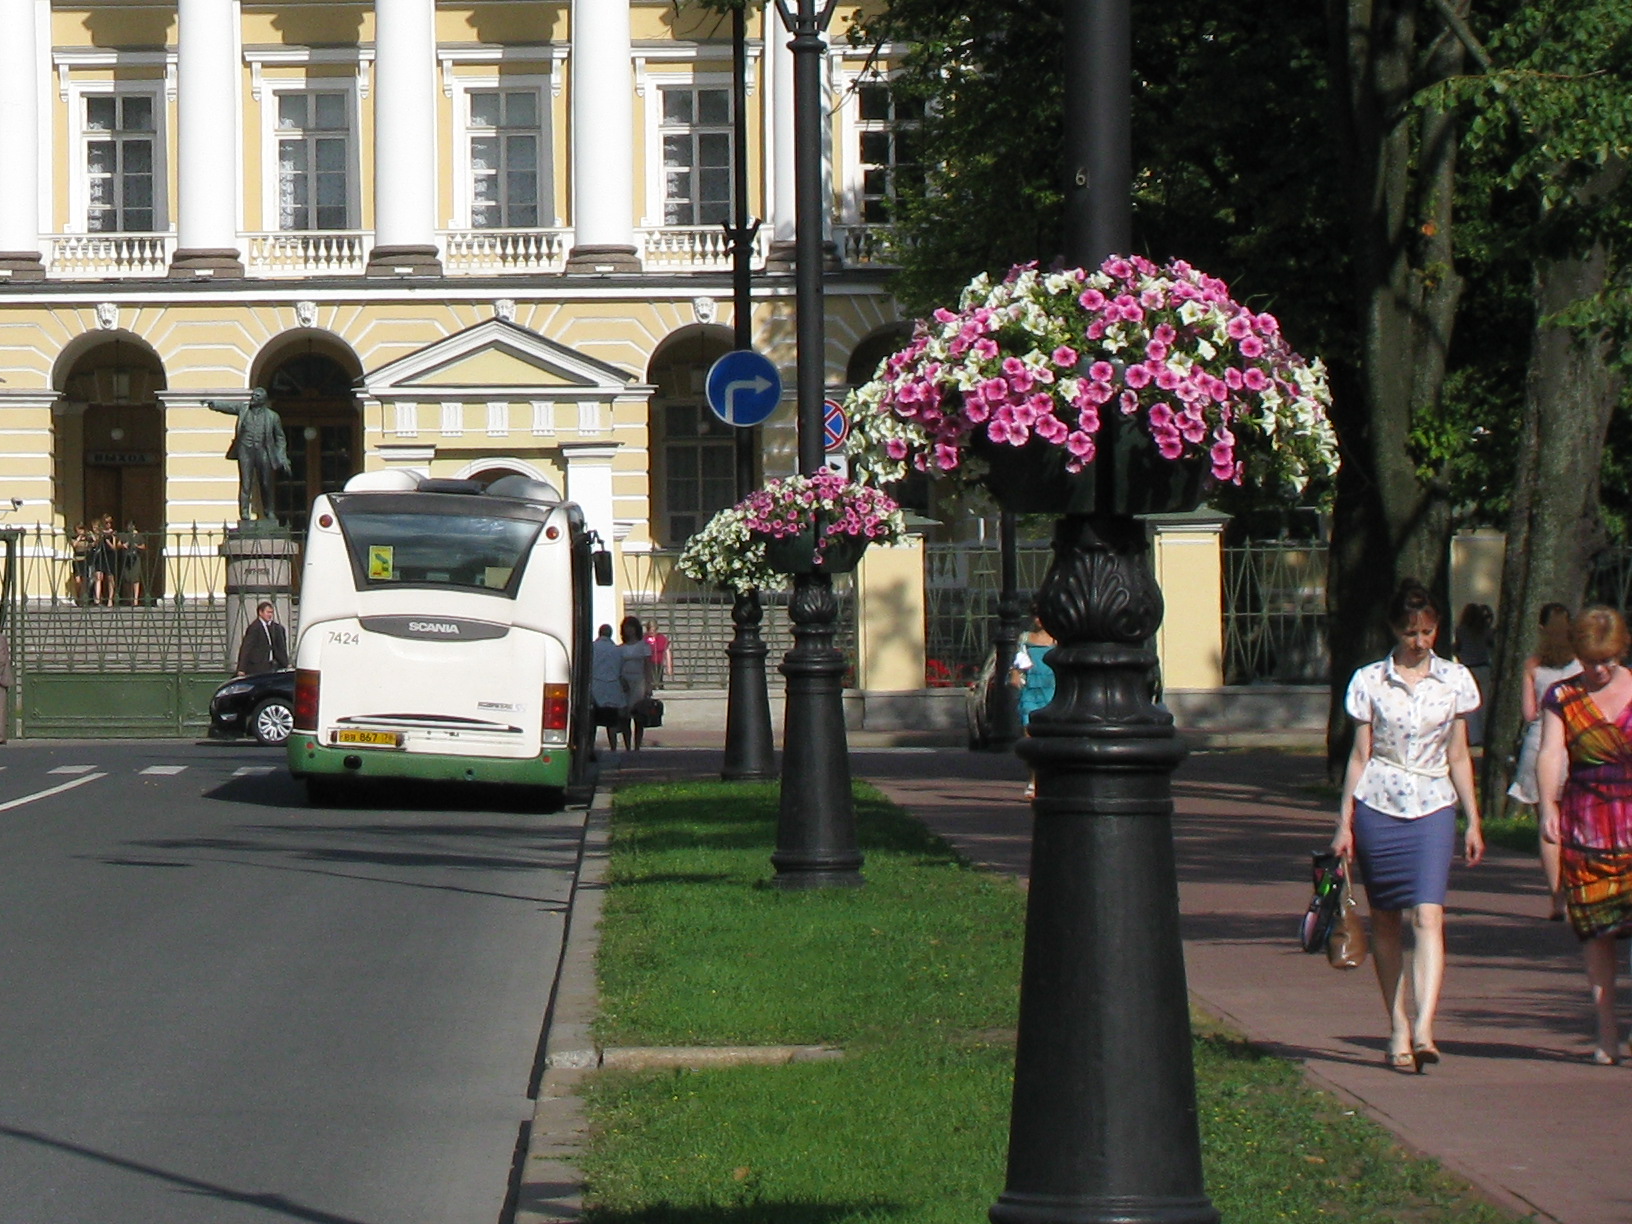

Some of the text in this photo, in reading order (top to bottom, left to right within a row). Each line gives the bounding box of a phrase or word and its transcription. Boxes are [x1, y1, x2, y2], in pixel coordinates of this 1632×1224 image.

[408, 621, 461, 634] SCANIA
[328, 631, 360, 645] 7424
[359, 732, 378, 742] 867
